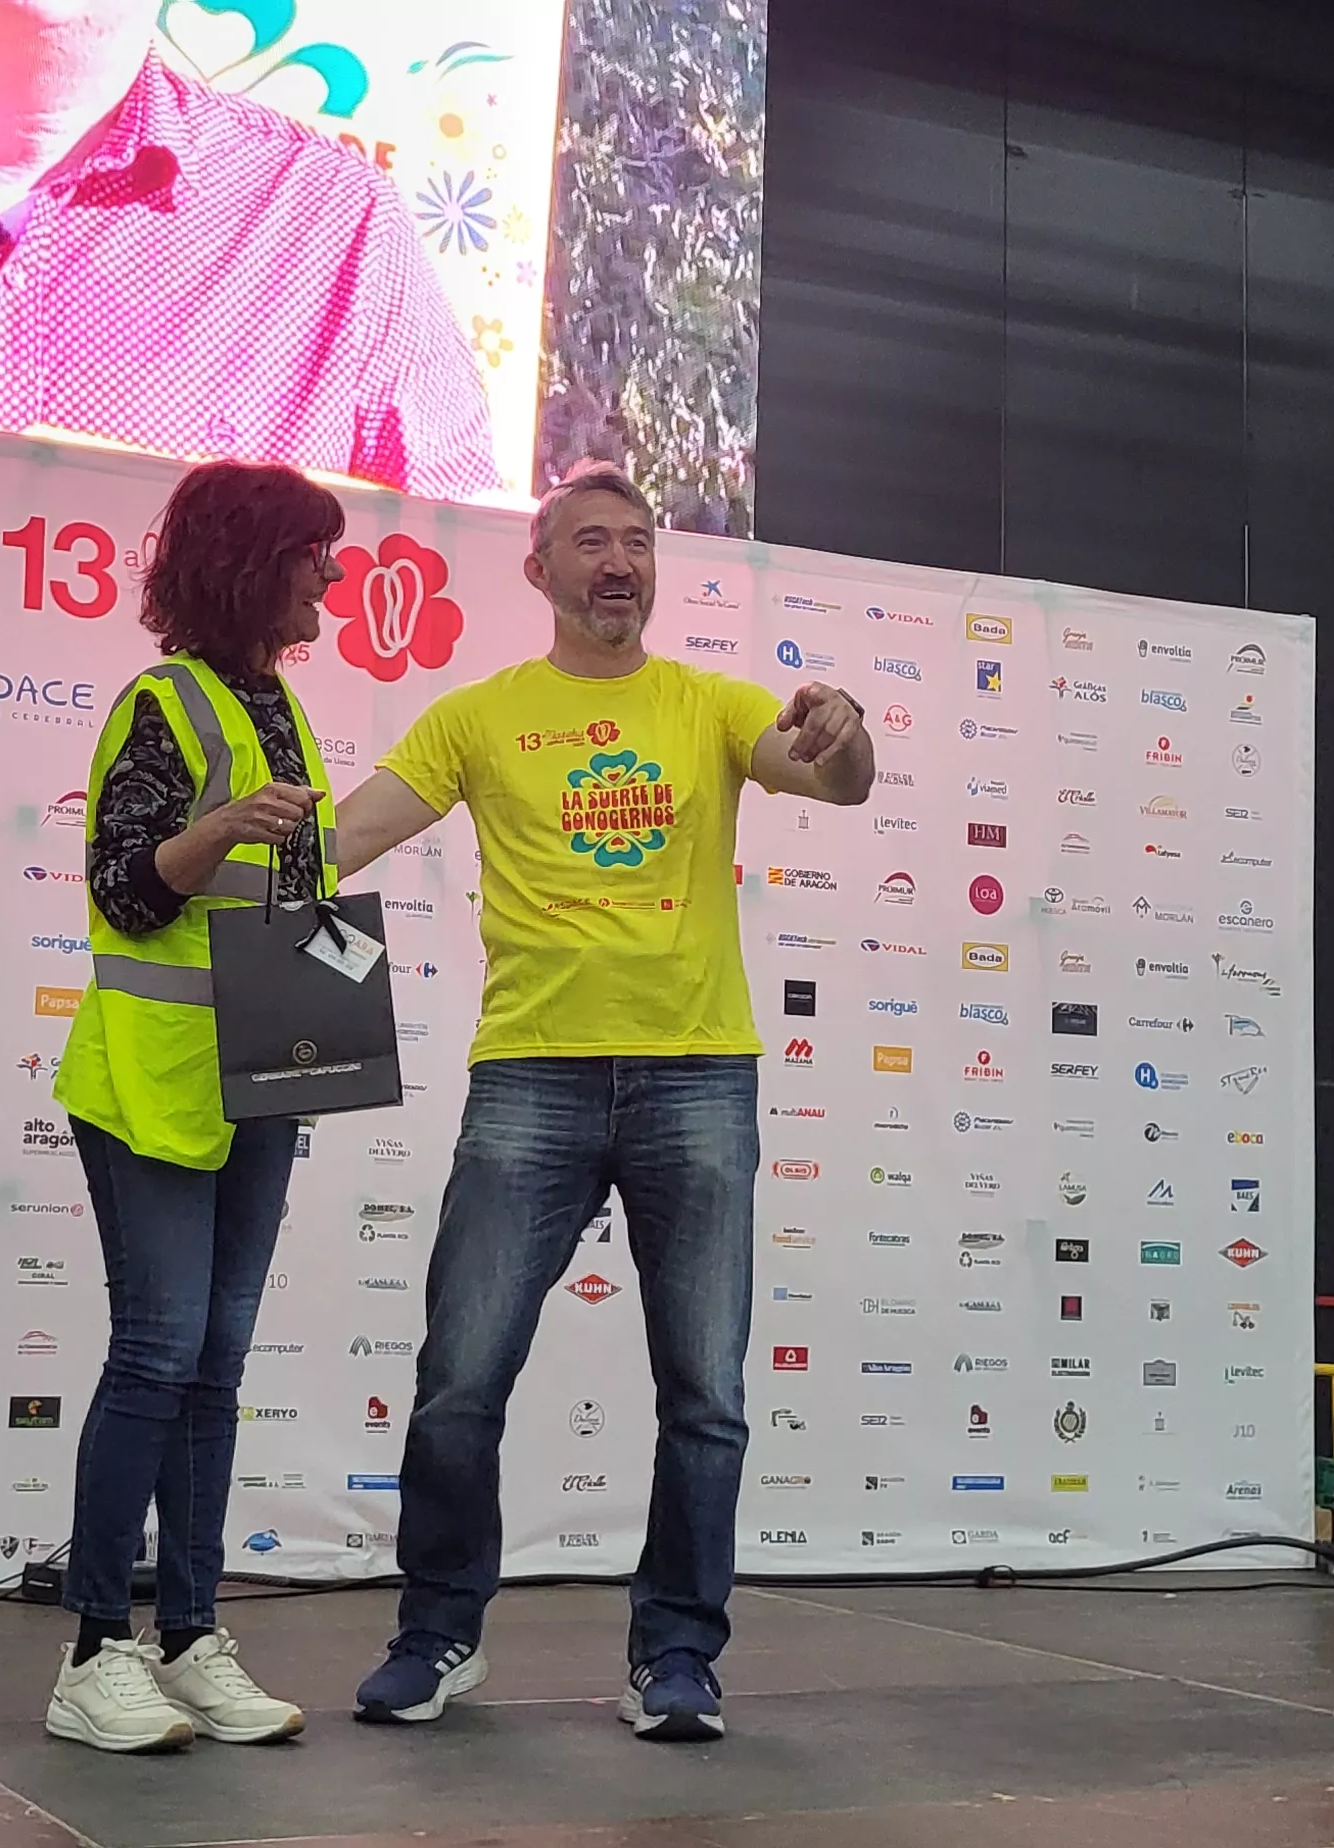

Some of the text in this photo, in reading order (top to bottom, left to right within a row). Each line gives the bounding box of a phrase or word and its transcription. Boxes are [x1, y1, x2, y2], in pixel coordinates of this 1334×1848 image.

[3, 515, 118, 619] 13
[887, 613, 933, 625] VIDAL
[974, 623, 1006, 636] Bada
[686, 637, 738, 651] SERFEY
[1152, 644, 1191, 657] envoltia
[874, 656, 917, 678] blasco
[977, 661, 995, 670] star
[1074, 681, 1106, 692] Gráficas
[1141, 689, 1182, 708] blasco
[12, 712, 94, 728] CEREBRAL
[516, 733, 541, 751] 13
[1146, 752, 1182, 763] FRIBIN
[561, 784, 673, 811] LA SUERTE DE
[562, 806, 674, 832] CONOCERNOS
[881, 816, 917, 830] levitec
[974, 825, 1000, 840] HM
[784, 869, 830, 880] GOBIERNO
[385, 900, 433, 913] envoltia
[1219, 915, 1273, 928] escanero
[882, 944, 927, 955] VIDAL
[969, 952, 1002, 962] Bada
[1149, 963, 1188, 974] envoltia
[41, 994, 79, 1010] Papsa
[960, 1003, 1002, 1022] blasco
[1129, 1017, 1172, 1029] Carrefour
[964, 1067, 1003, 1077] FRIBIN
[1051, 1064, 1098, 1076] SERFEY
[24, 1118, 54, 1134] alto
[888, 1171, 911, 1183] walqa
[11, 1203, 68, 1214] serunion
[1228, 1248, 1259, 1258] KUHN
[574, 1282, 612, 1294] KUHN
[375, 1342, 413, 1350] RIEGOS
[975, 1358, 1007, 1367] RIEGOS
[256, 1409, 297, 1418] XERYO
